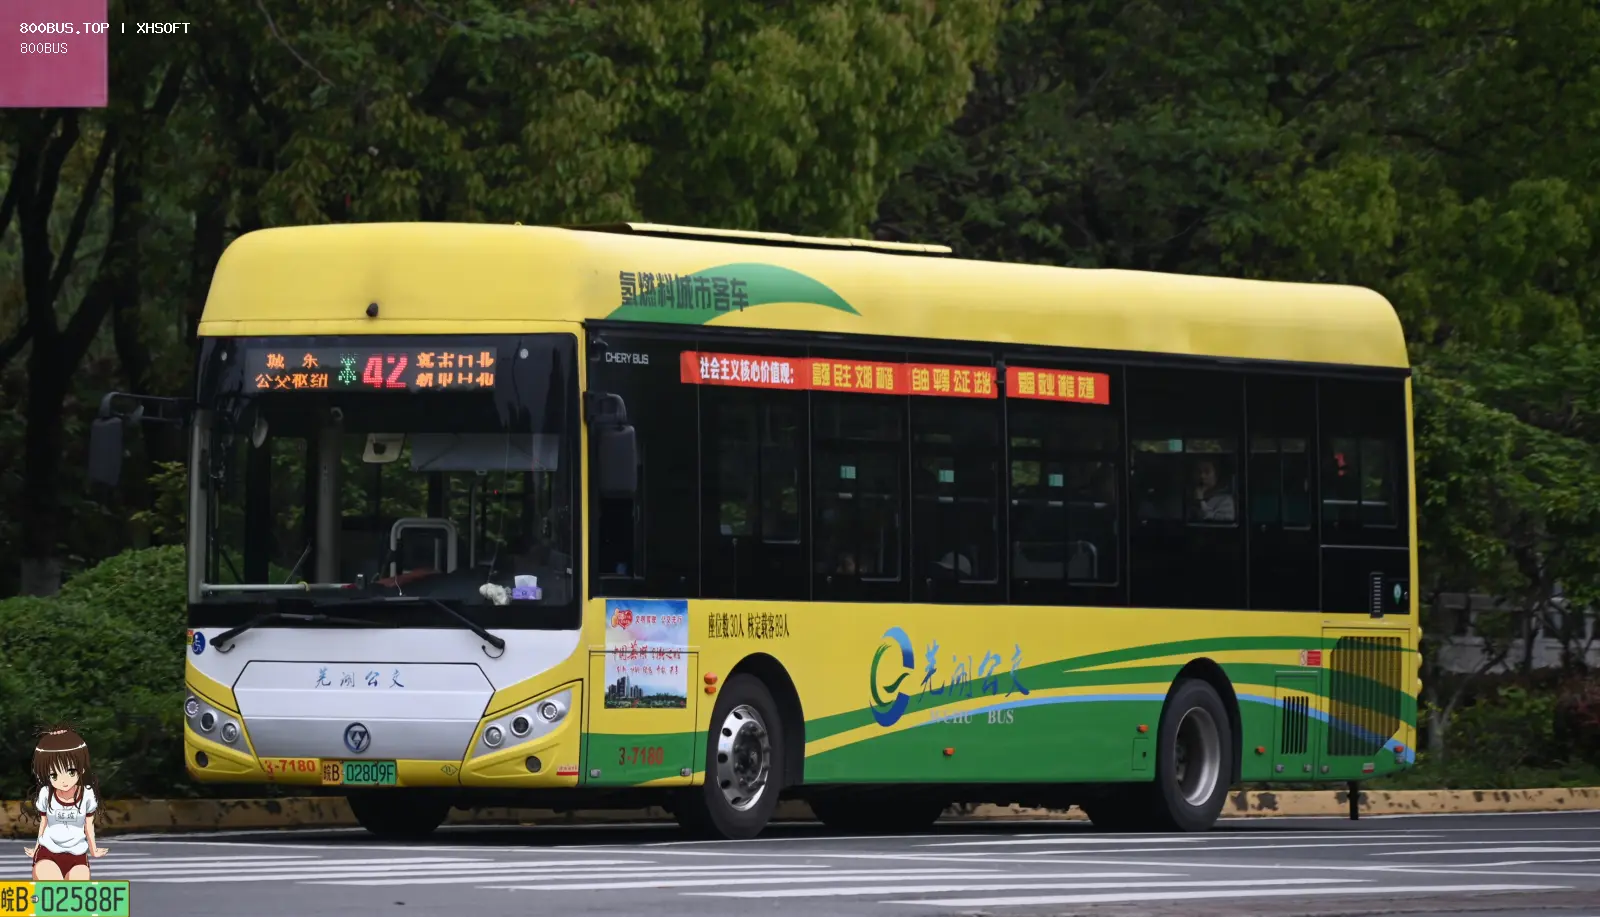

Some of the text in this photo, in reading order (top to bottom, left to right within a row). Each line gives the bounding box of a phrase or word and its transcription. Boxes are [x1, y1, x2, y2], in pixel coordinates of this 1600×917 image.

[619, 270, 750, 313] 氢燃料城市客车
[362, 352, 408, 388] 42
[605, 352, 649, 365] CHERY BUS
[812, 362, 831, 387] 富强
[834, 363, 852, 388] 民主
[855, 365, 873, 389] 文明
[876, 366, 894, 390] 和谐
[912, 367, 930, 391] 自由
[933, 368, 950, 392] 平等
[954, 369, 971, 393] 公正
[974, 370, 991, 394] 法治
[987, 709, 1014, 724] BUS
